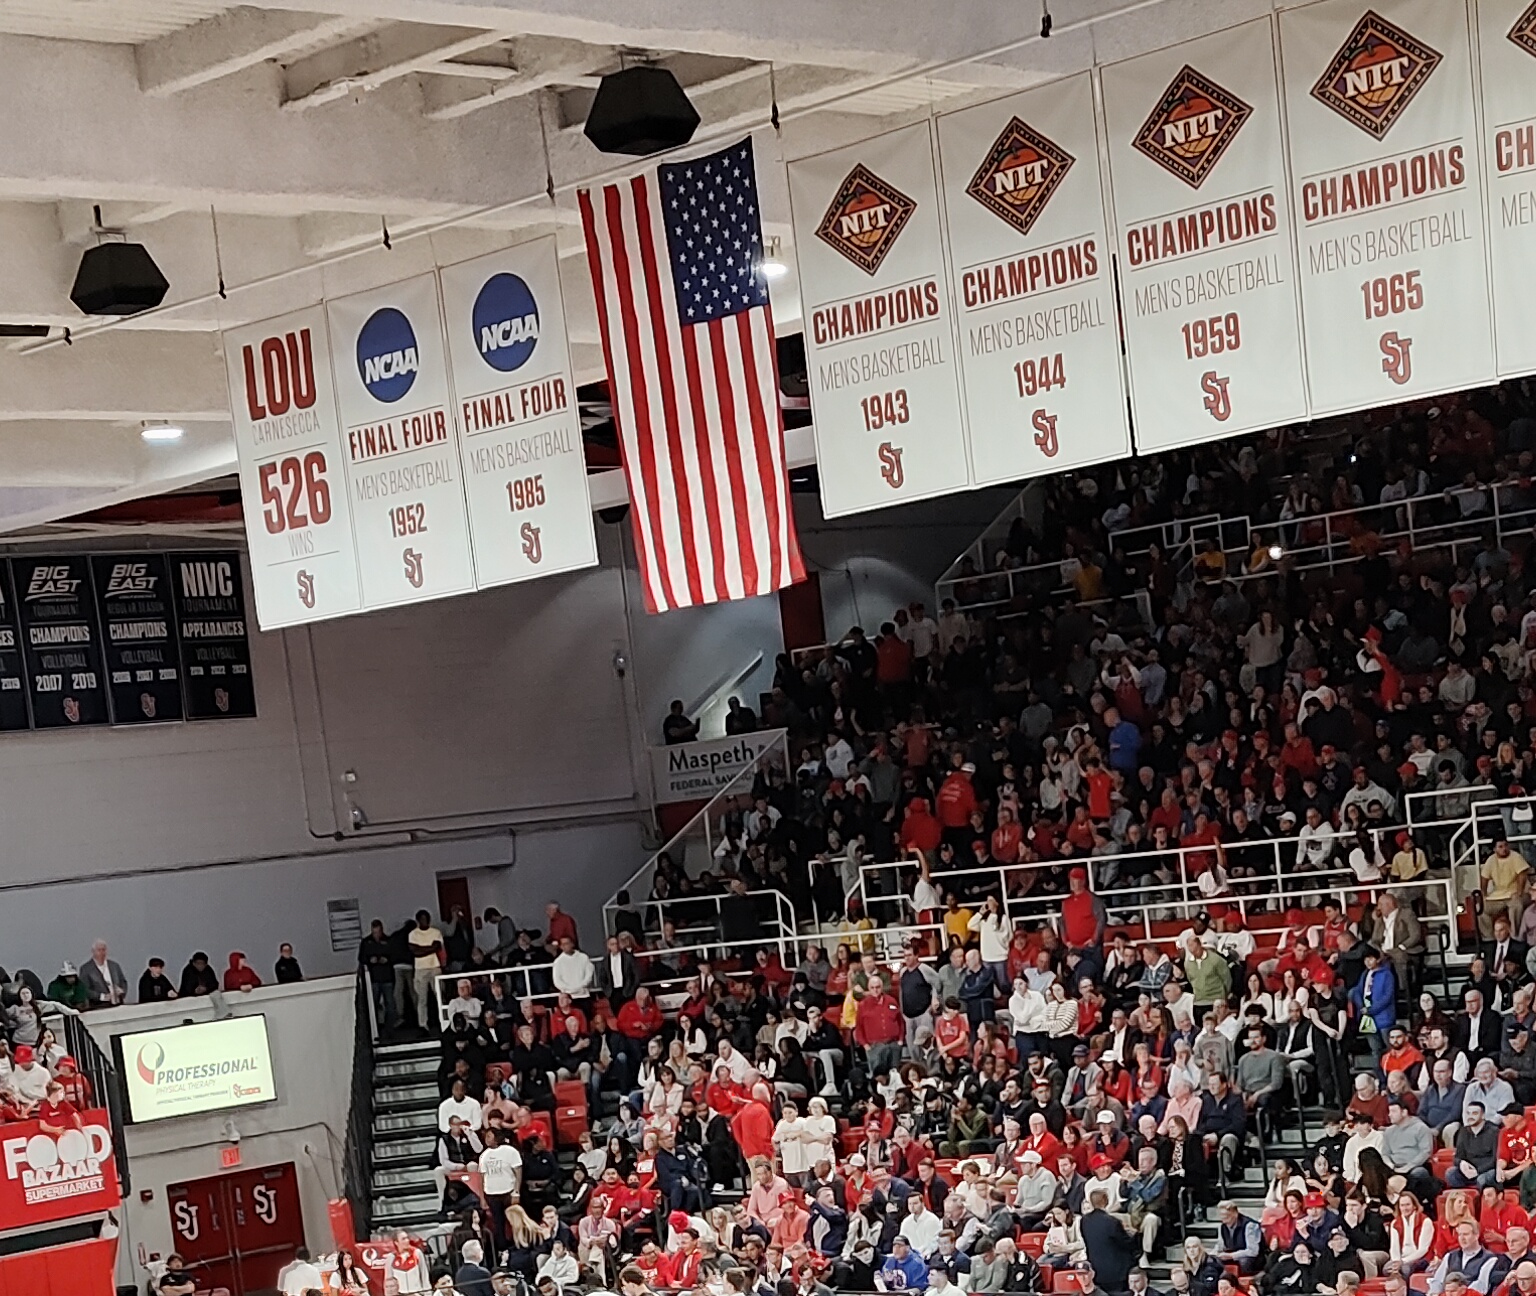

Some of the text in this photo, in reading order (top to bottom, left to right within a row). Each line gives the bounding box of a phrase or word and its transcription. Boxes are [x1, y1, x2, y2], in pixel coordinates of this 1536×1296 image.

[1342, 54, 1412, 98] NIT
[1161, 105, 1224, 149] NIT
[992, 158, 1050, 196] NIT
[1301, 143, 1466, 222] CHAMPIONS
[839, 203, 891, 240] NIT
[1126, 192, 1278, 266] CHAMPIONS
[1308, 208, 1472, 276] MEN'S BASKETBALL
[962, 239, 1099, 308] CHAMPIONS
[1134, 253, 1285, 318] MEN'S BASKETBALL
[812, 280, 940, 345] CHAMPIONS
[1360, 270, 1424, 320] 1965
[481, 313, 539, 353] NCAA
[969, 296, 1106, 357] MEN'S BASKETBALL
[1181, 312, 1241, 360] 1959
[242, 328, 317, 421] LOU
[364, 347, 418, 384] NCAA
[819, 336, 946, 392] MEN'S BASKETBALL
[1013, 352, 1066, 398] 1944
[463, 378, 567, 433] FINAL FOUR
[861, 388, 910, 432] 1943
[251, 412, 321, 447] CARNESECCA
[349, 410, 448, 460] FINAL FOUR
[469, 427, 574, 475] MEN'S BASKETBALL
[259, 450, 331, 535] 526
[355, 459, 453, 501] MEN'S BASKETBALL
[506, 474, 546, 512] 1985
[389, 502, 427, 538] 1952
[288, 530, 314, 558] WINS
[29, 578, 81, 594] EAST
[32, 565, 70, 582] BIG
[108, 575, 158, 592] EAST
[111, 563, 147, 579] BIG
[180, 561, 234, 597] NIVC
[30, 623, 90, 643] CHAMPIONS
[109, 619, 167, 639] CHAMPIONS
[182, 621, 244, 639] APPEARANCES
[36, 672, 97, 691] 2007 2019
[669, 740, 755, 774] Maspeth
[670, 777, 714, 791] FEDERAL
[157, 1057, 258, 1085] PROFESSIONAL
[3, 1124, 112, 1181] FOOD
[22, 1158, 104, 1187] BAZAAR
[25, 1174, 105, 1203] SUPERMARKET
